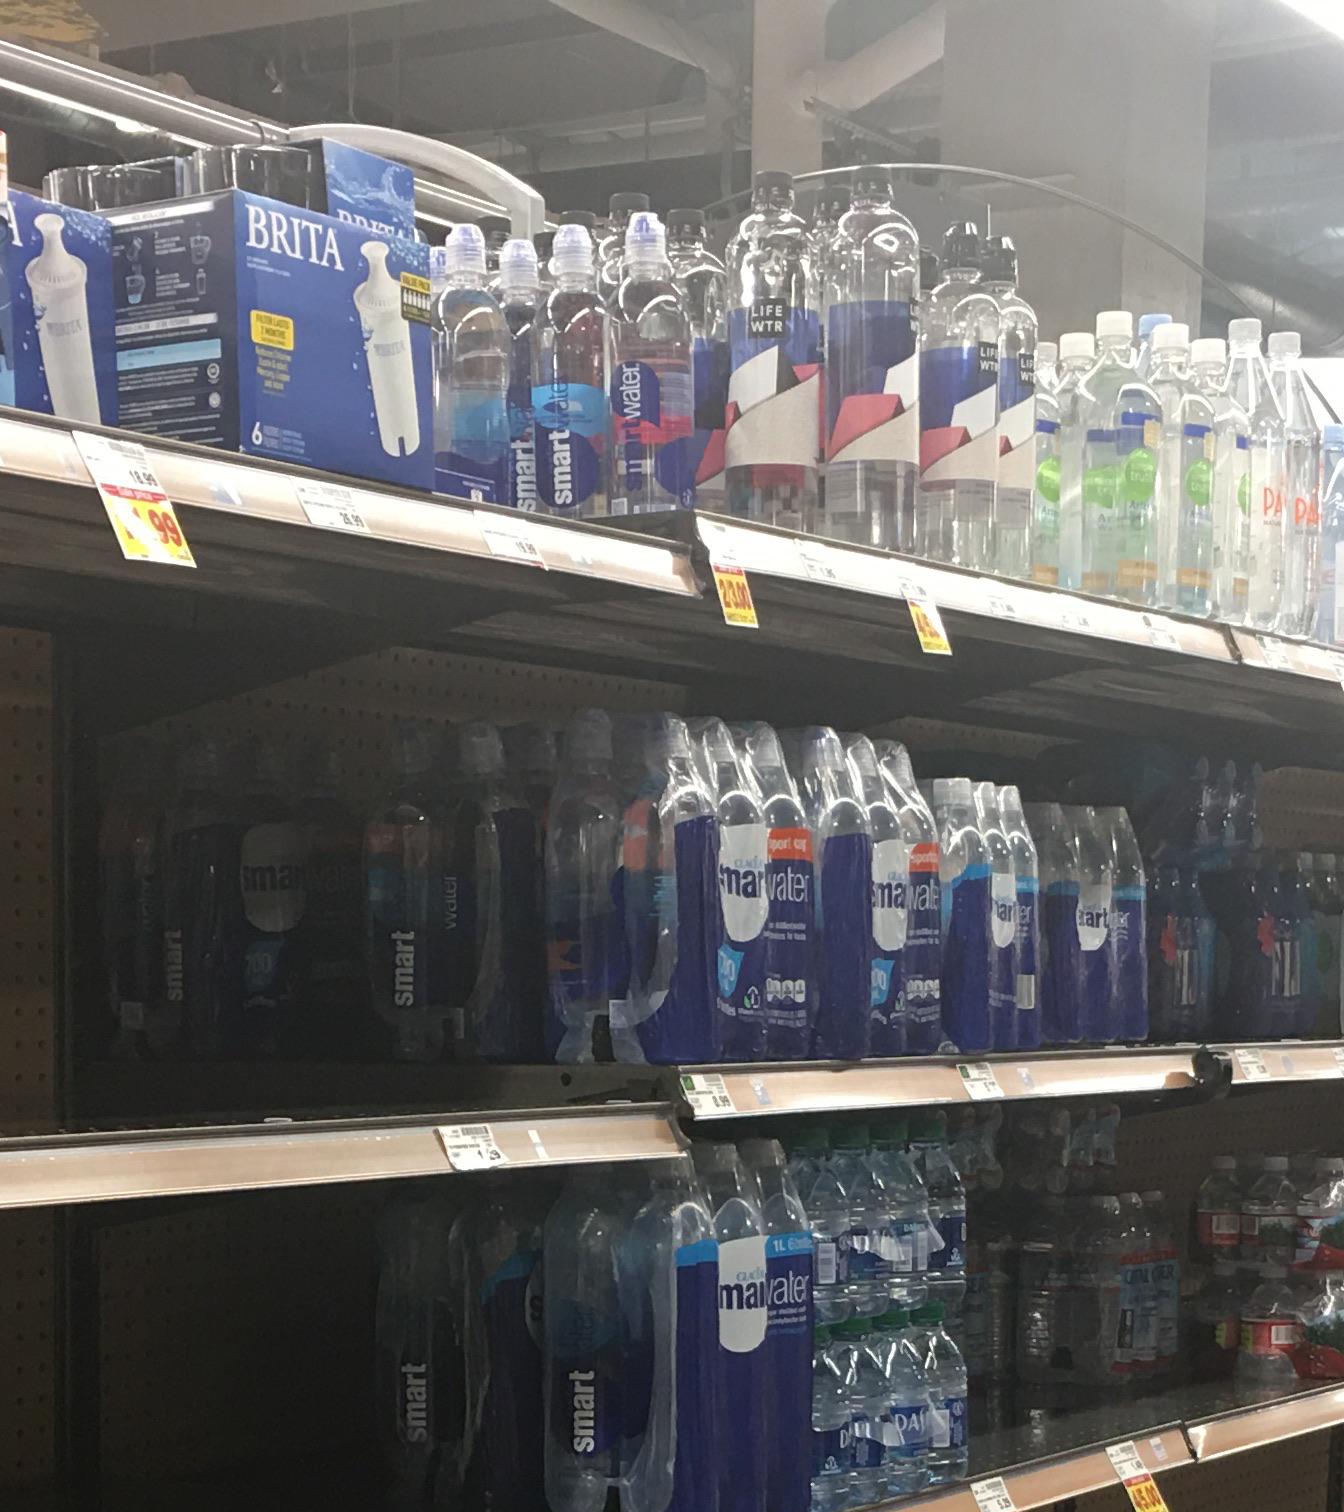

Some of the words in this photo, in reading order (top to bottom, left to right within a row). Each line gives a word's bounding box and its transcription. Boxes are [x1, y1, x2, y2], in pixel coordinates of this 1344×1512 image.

[246, 205, 345, 271] BRITA
[751, 320, 783, 333] WTR
[752, 304, 783, 317] LIFE
[252, 422, 262, 445] 6
[402, 1363, 427, 1443] smart
[569, 1370, 595, 1454] smart
